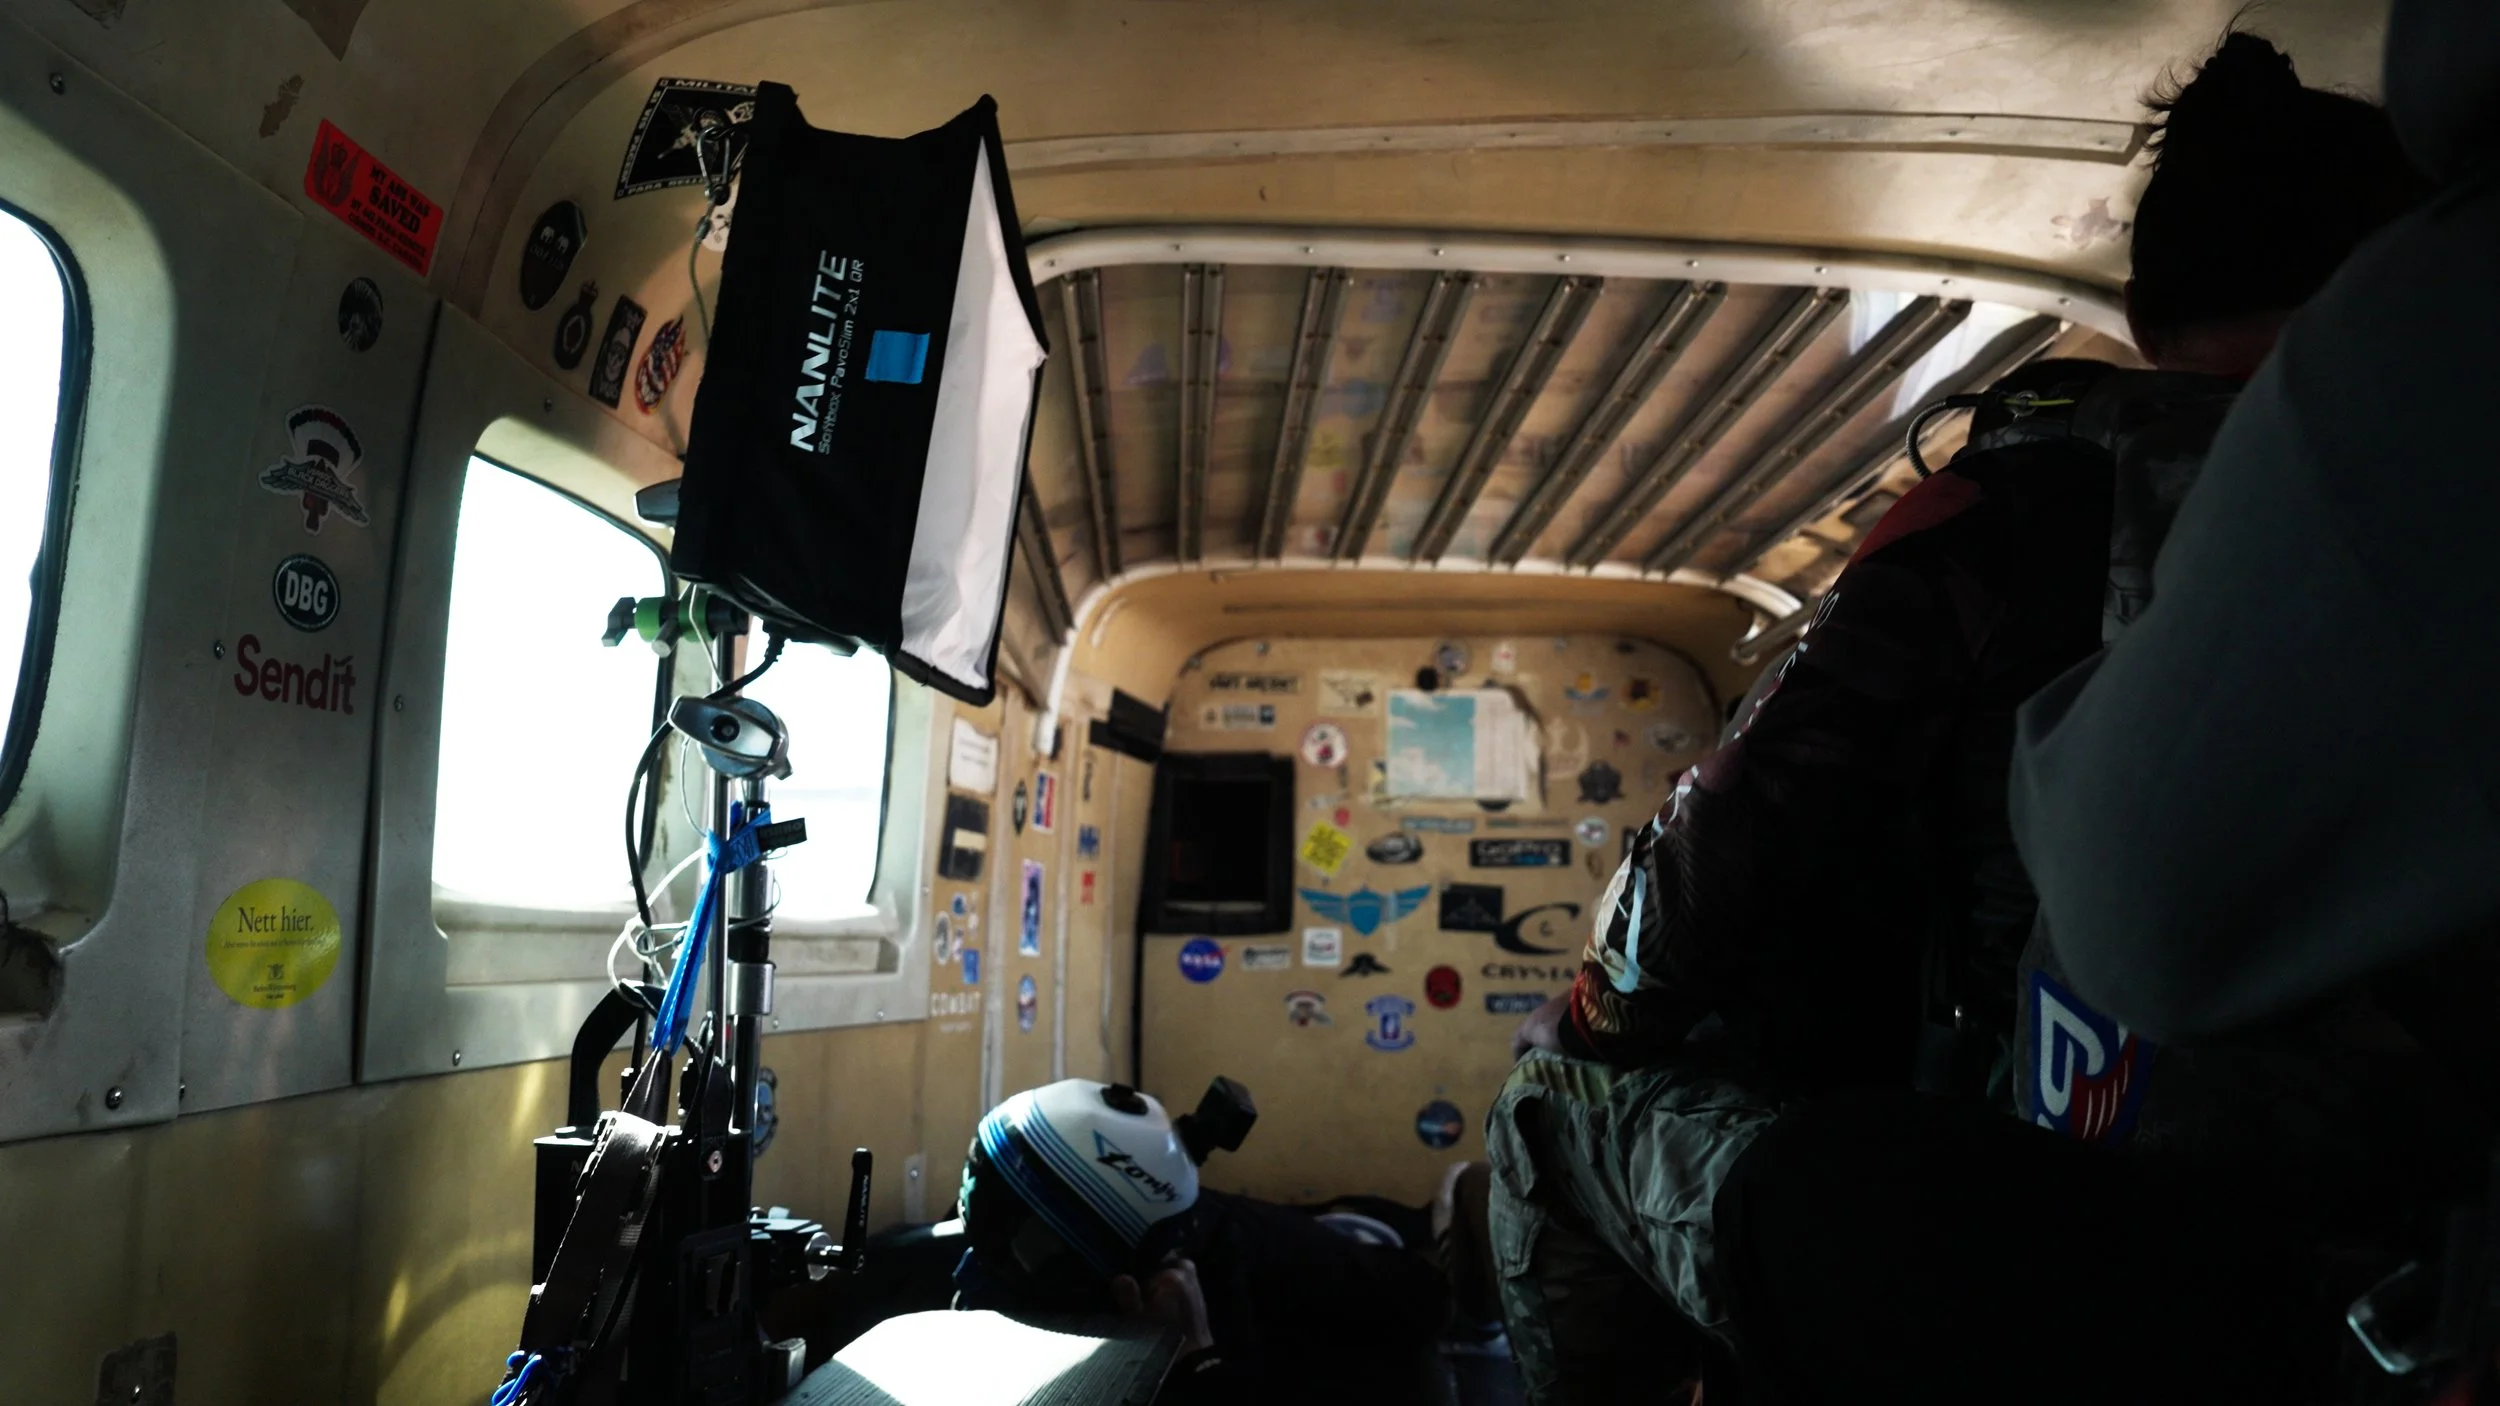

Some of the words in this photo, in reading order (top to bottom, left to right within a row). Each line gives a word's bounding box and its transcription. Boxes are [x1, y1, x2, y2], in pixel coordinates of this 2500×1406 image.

[369, 186, 421, 234] SAVED
[790, 249, 848, 453] NANLITE
[817, 391, 843, 456] Softbox
[830, 319, 855, 389] PavoSlim
[849, 258, 865, 283] QR
[284, 569, 329, 616] DBG
[238, 906, 276, 933] Nett
[280, 905, 315, 933] hier.
[1182, 952, 1222, 968] NASA
[1482, 963, 1575, 981] CRYSTA
